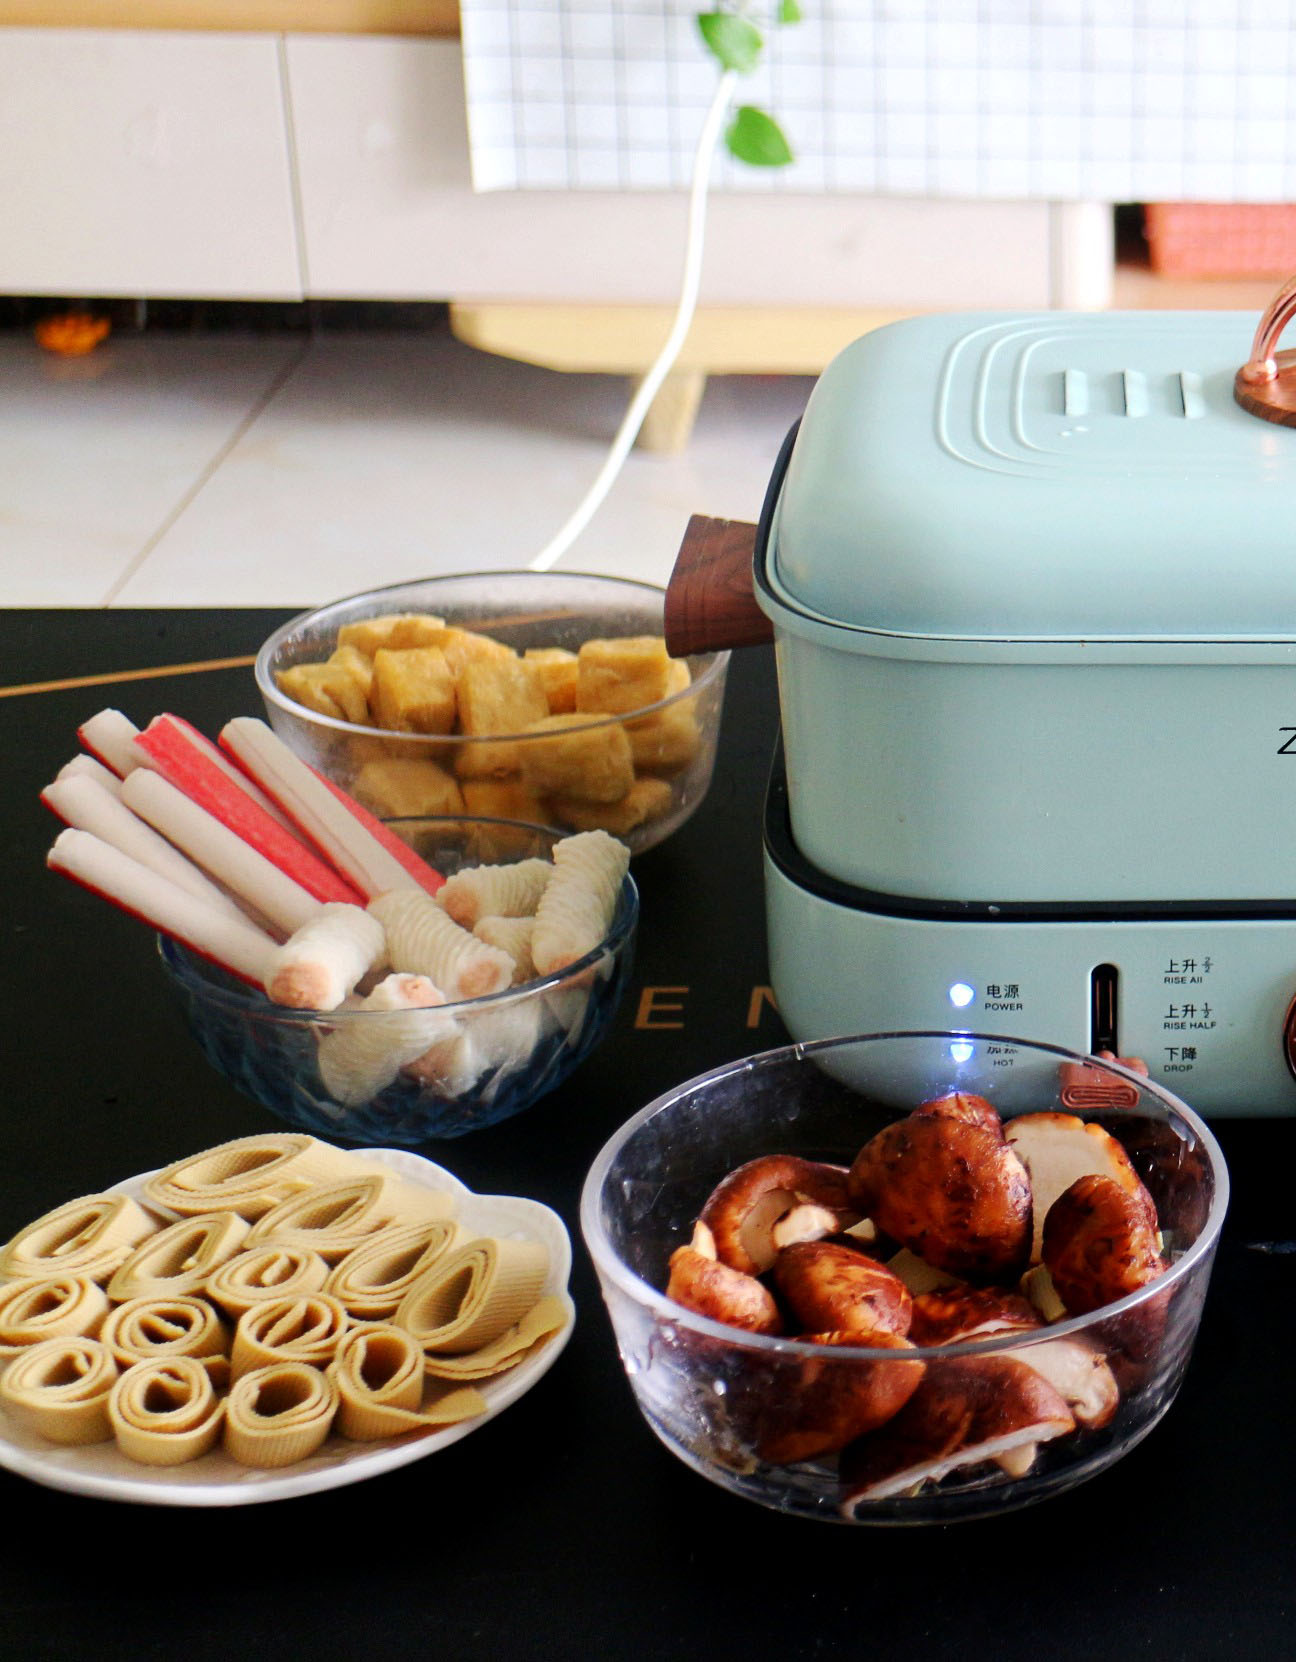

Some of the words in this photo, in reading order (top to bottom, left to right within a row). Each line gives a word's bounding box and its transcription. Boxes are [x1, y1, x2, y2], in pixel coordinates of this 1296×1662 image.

[1164, 959, 1198, 973] 上升
[1163, 976, 1187, 984] RISE
[986, 984, 1020, 999] 电源
[984, 1002, 1024, 1011] POWER
[1164, 1003, 1198, 1018] 上升
[1163, 1021, 1187, 1030] RISE
[1189, 1021, 1217, 1030] HALF
[1163, 1046, 1198, 1061] 下降
[1163, 1064, 1193, 1072] DROP
